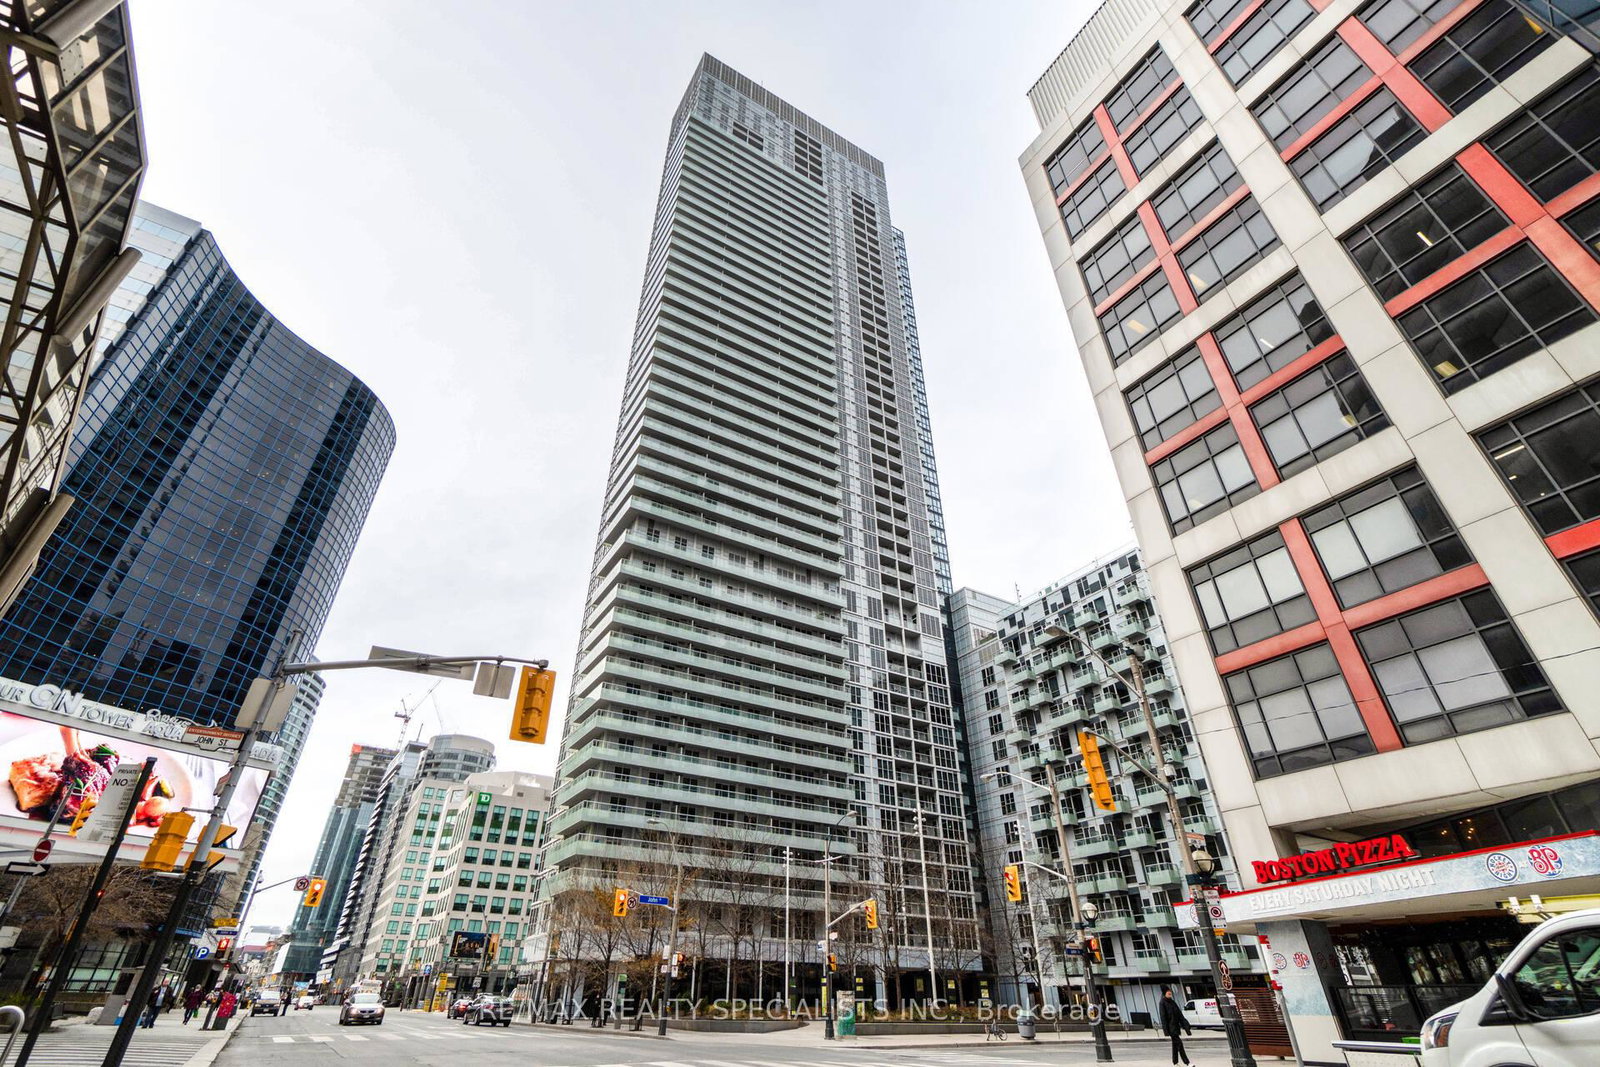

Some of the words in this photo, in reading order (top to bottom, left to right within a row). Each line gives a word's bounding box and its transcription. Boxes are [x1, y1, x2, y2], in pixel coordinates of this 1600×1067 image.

[0, 683, 25, 702] UR
[30, 683, 85, 714] CN
[79, 705, 134, 729] TOWER
[142, 719, 184, 740] AQUA
[252, 746, 279, 763] ADA
[193, 735, 215, 745] JOHN
[217, 738, 229, 747] ST
[112, 778, 129, 787] NO
[479, 794, 491, 803] TD
[1251, 848, 1335, 883] BOSTON
[1333, 835, 1415, 868] PIZZA
[1528, 847, 1558, 875] BP
[1248, 890, 1292, 911] EVERY
[1294, 877, 1375, 904] SATURDAY
[1377, 868, 1436, 892] NIGHT
